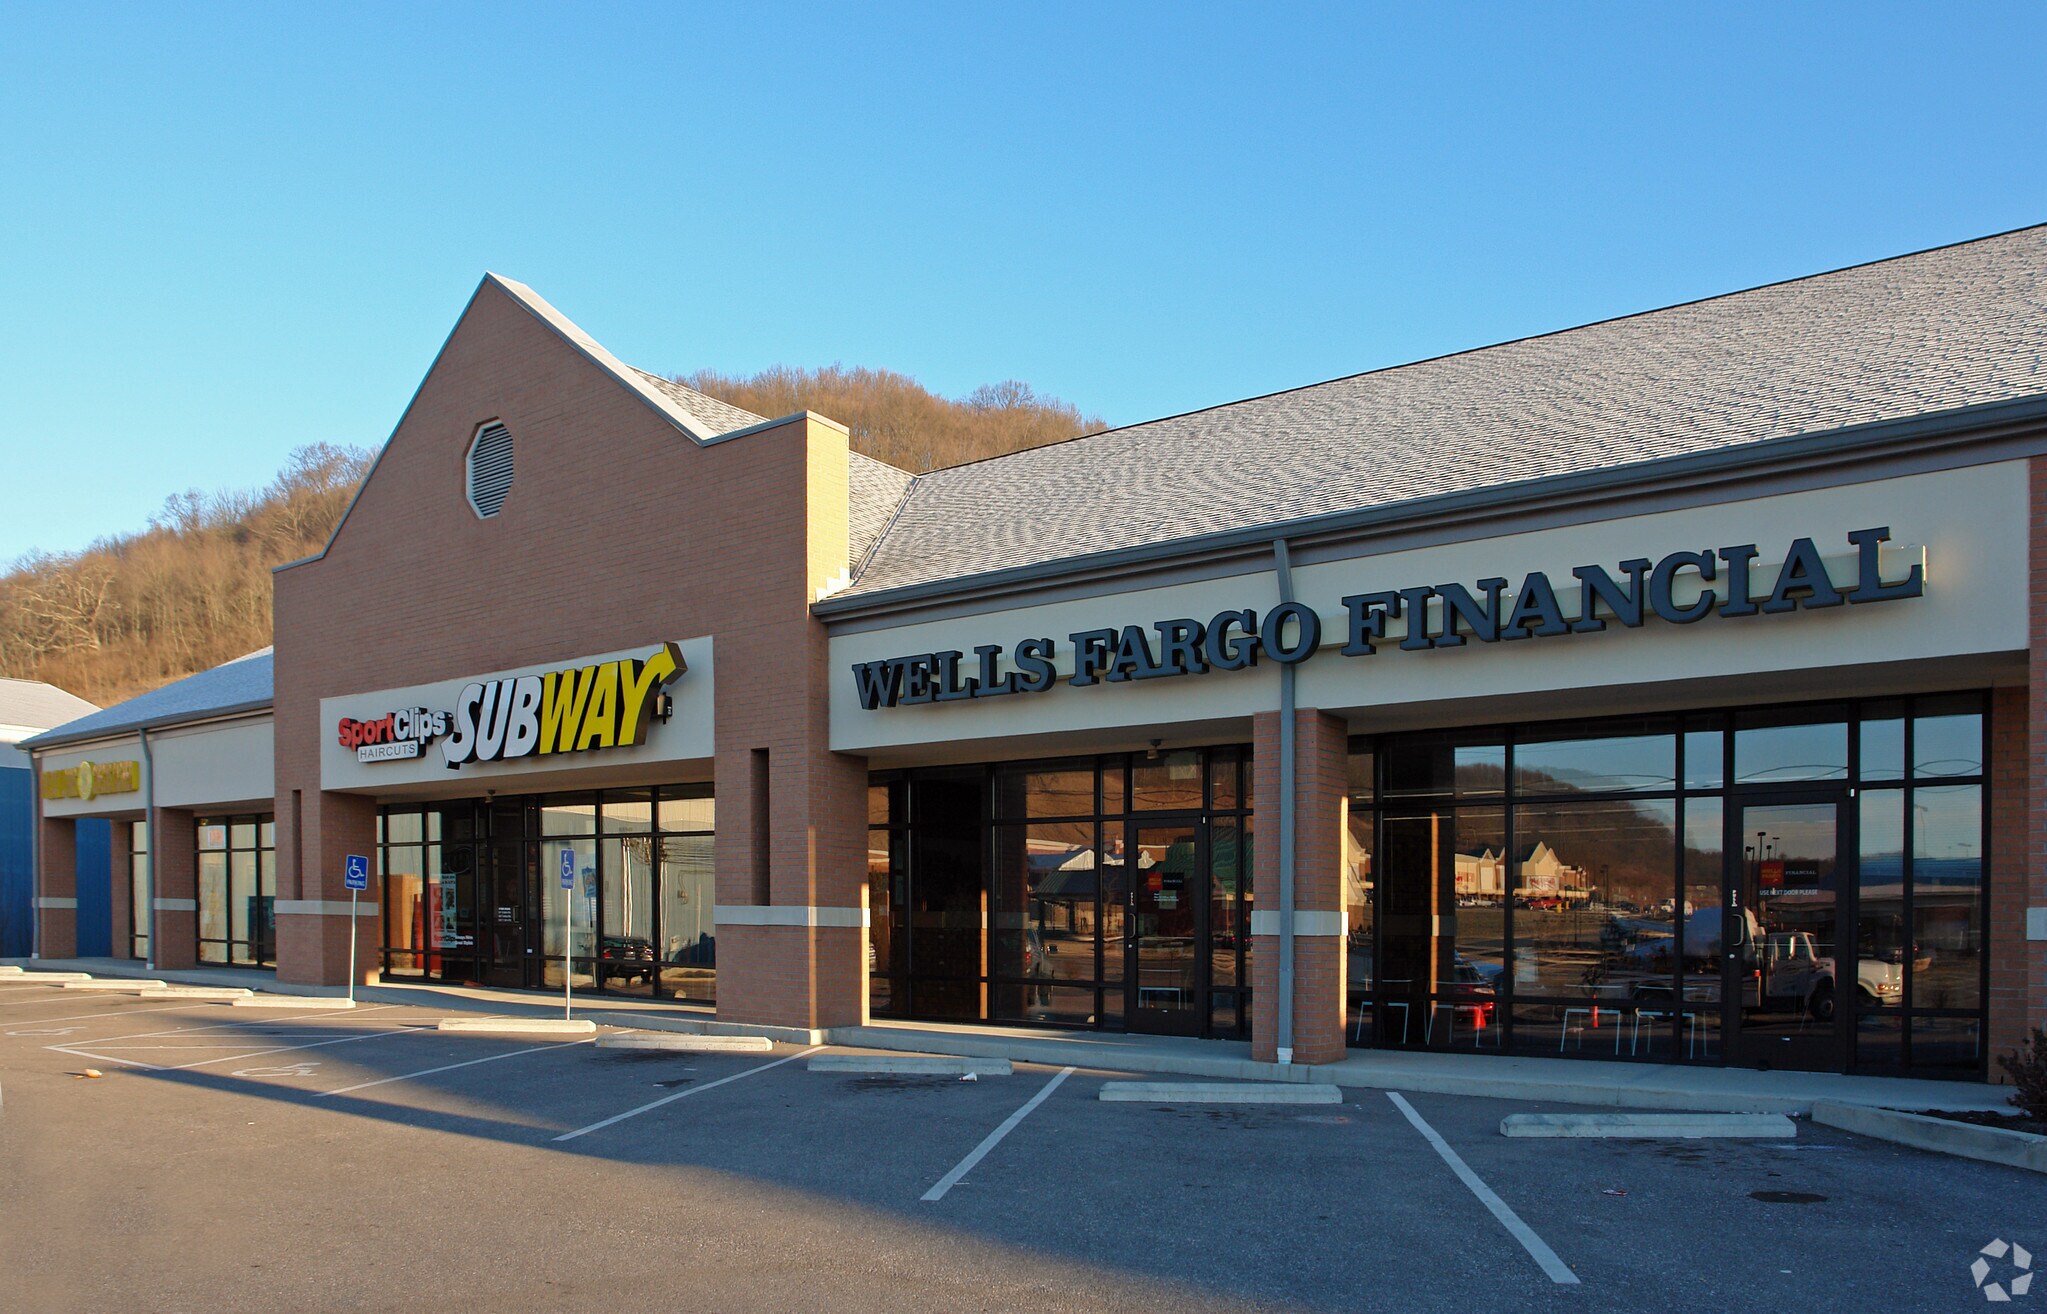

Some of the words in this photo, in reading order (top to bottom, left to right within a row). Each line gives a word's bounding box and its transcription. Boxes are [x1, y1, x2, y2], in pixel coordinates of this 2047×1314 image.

[852, 638, 1056, 710] WELLS
[1069, 602, 1321, 688] FARGO
[1341, 527, 1925, 656] FINANCIAL
[360, 744, 416, 759] HAIRCUTS
[440, 641, 688, 770] SUBWAY
